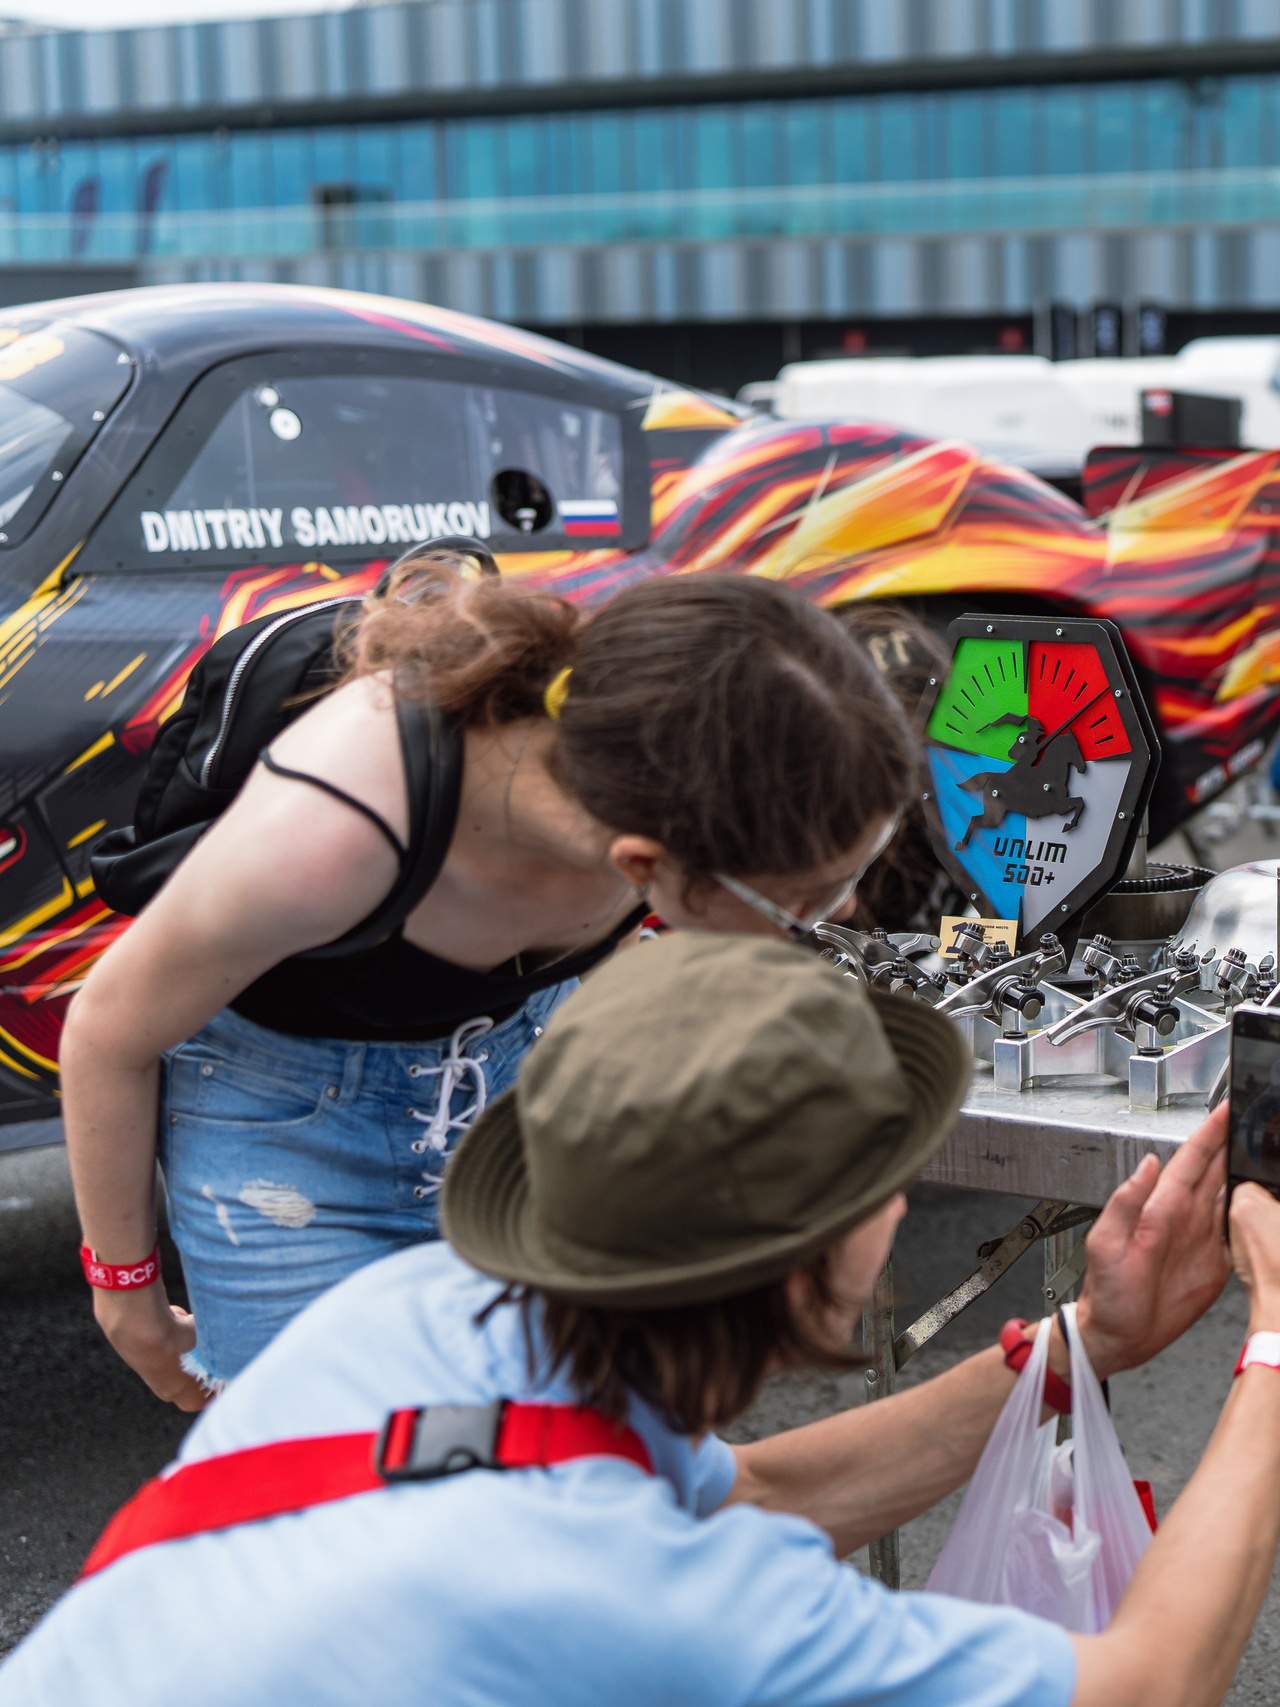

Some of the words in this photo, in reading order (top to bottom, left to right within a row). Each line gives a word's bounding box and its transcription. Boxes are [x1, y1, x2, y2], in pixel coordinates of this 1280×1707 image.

[140, 508, 284, 552] DMITRIY
[290, 501, 492, 547] SAMORUKOV
[994, 836, 1068, 864] UNLIM
[1002, 863, 1056, 887] 500+
